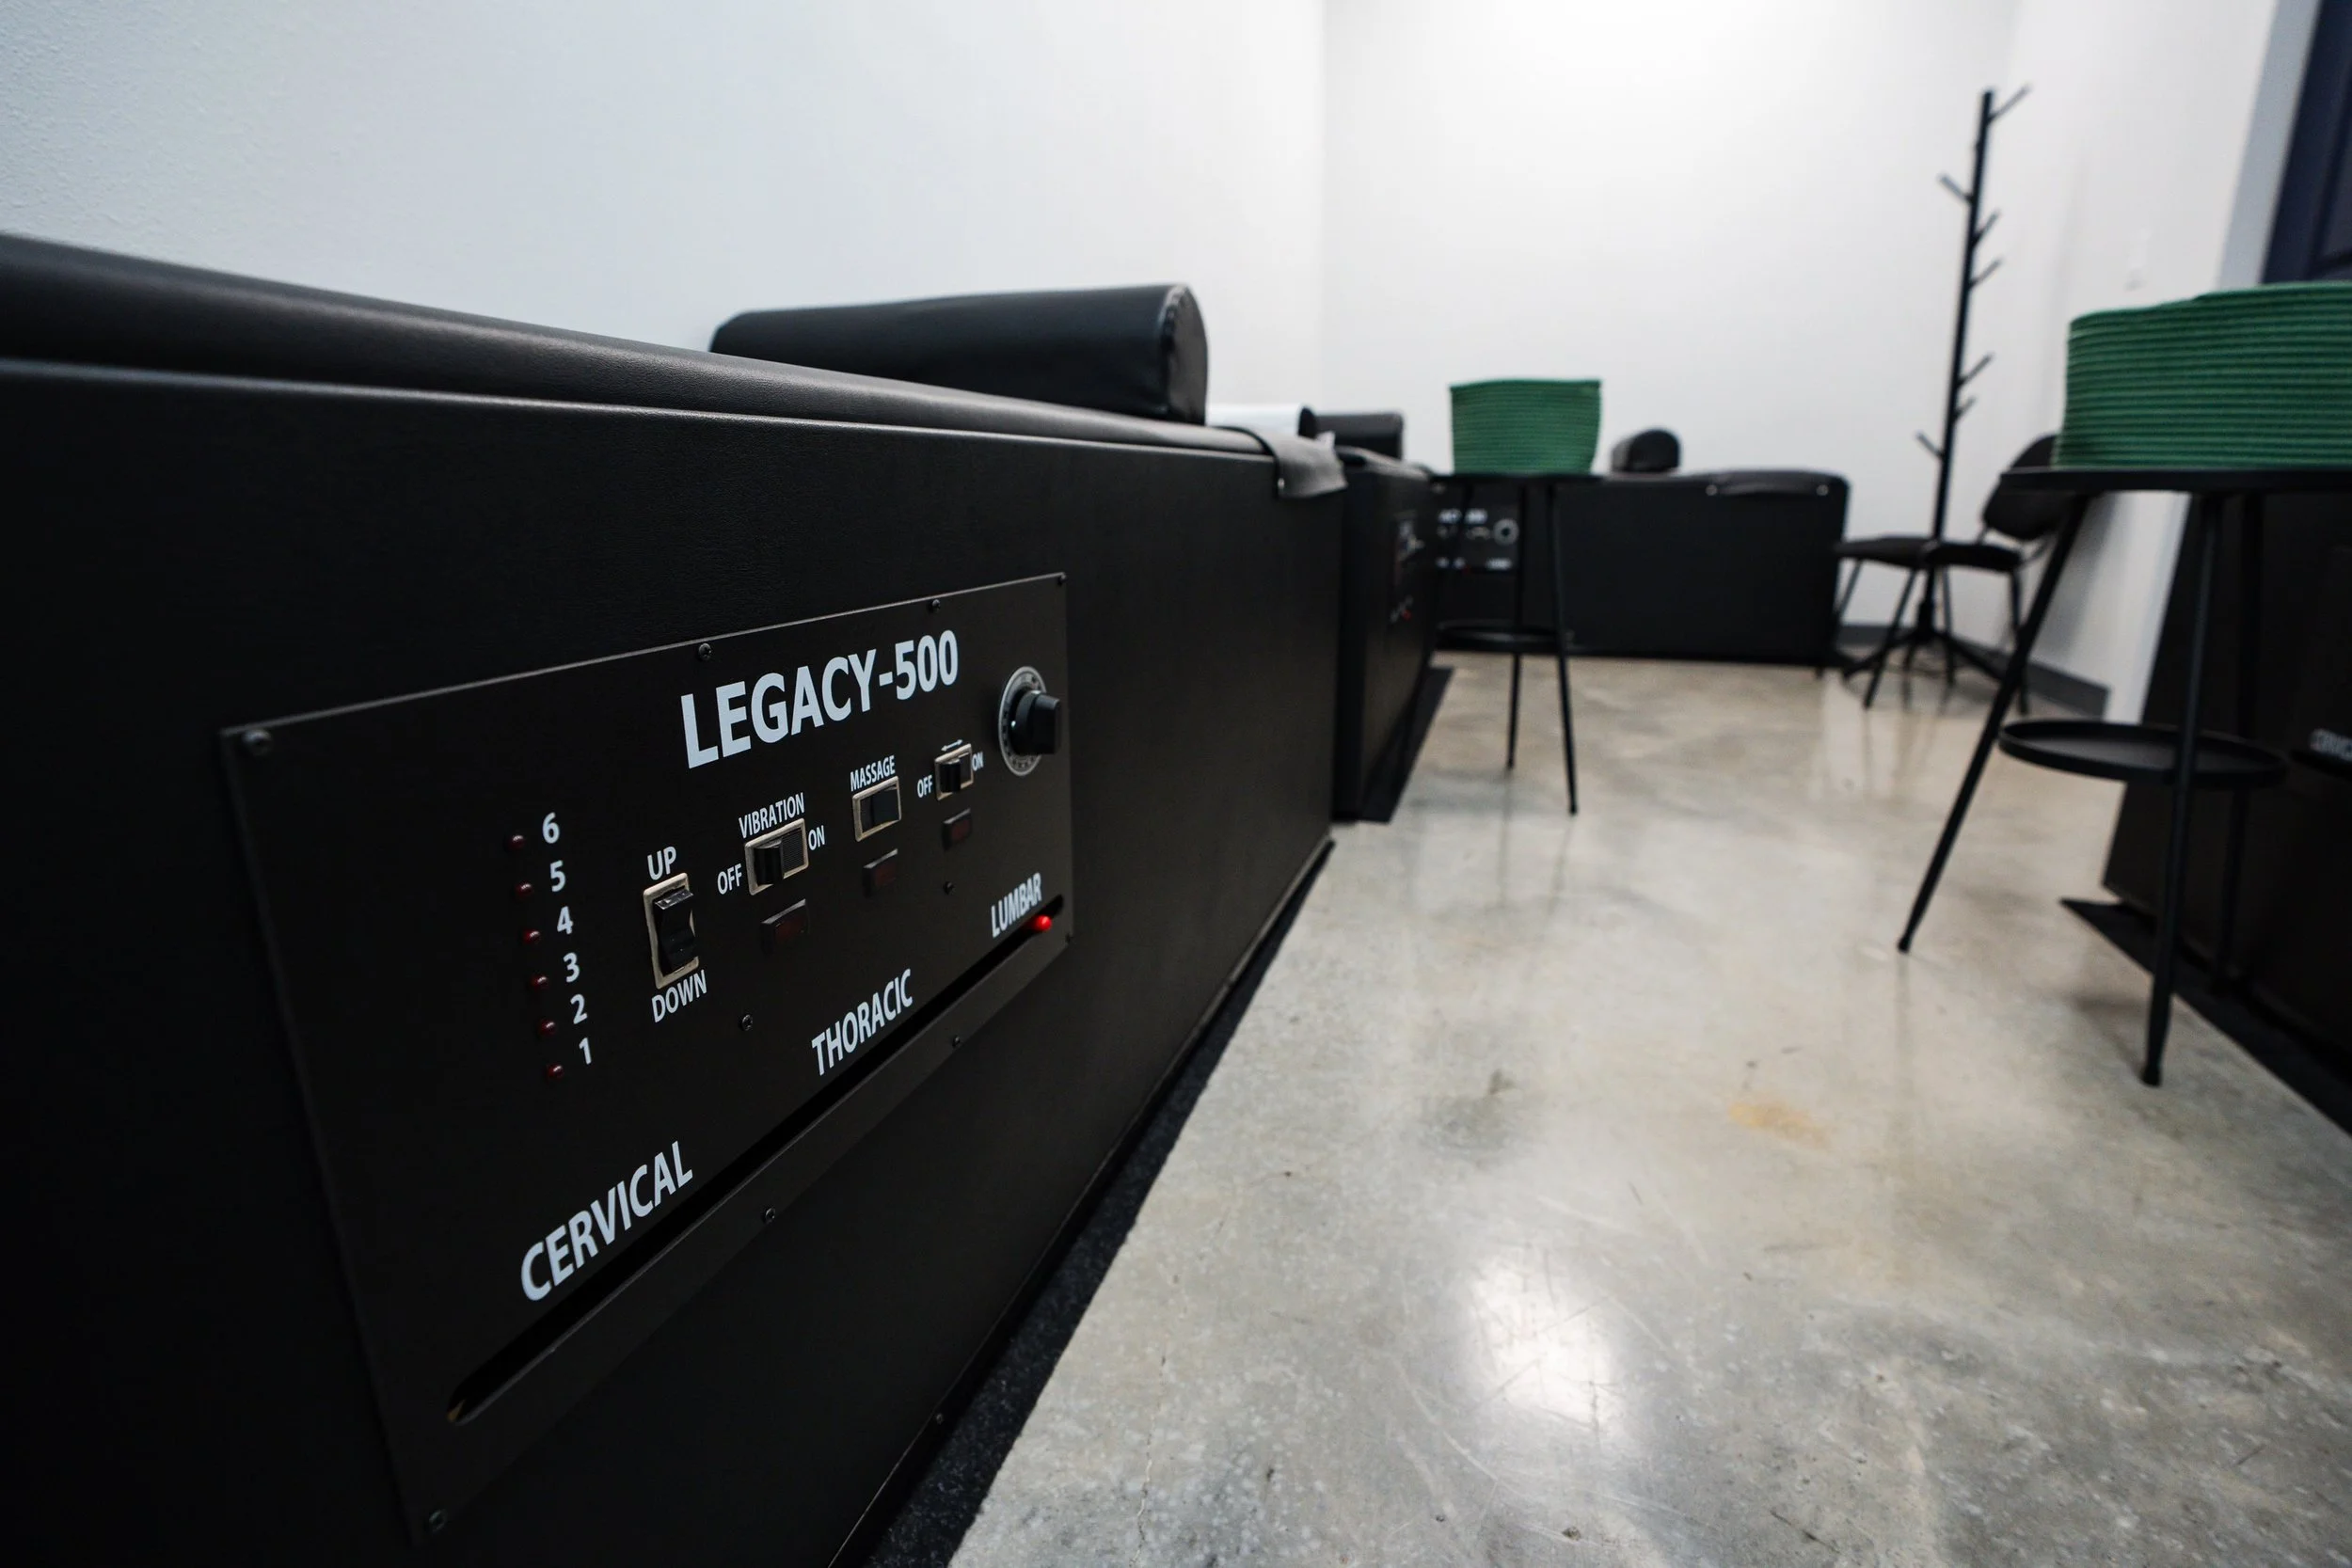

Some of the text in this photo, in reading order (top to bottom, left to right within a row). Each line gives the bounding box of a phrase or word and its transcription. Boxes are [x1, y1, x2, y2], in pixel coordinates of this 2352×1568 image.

[681, 629, 958, 768] LEGACY-500
[850, 755, 896, 792] MASSAGE
[916, 774, 933, 799] OFF
[971, 752, 984, 771] ON
[542, 812, 560, 844] 6
[739, 793, 805, 839] VIBRATION
[549, 860, 566, 893] 5
[647, 847, 677, 881] UP
[717, 824, 826, 895] OFF ON
[556, 906, 574, 935] 4
[991, 872, 1042, 938] LUMBAR
[563, 952, 580, 983] 3
[570, 993, 588, 1025] 2
[652, 970, 707, 1022] DOWN
[812, 968, 914, 1076] THORACIC
[579, 1037, 592, 1065] 1
[521, 1140, 693, 1301] CERVICAL
